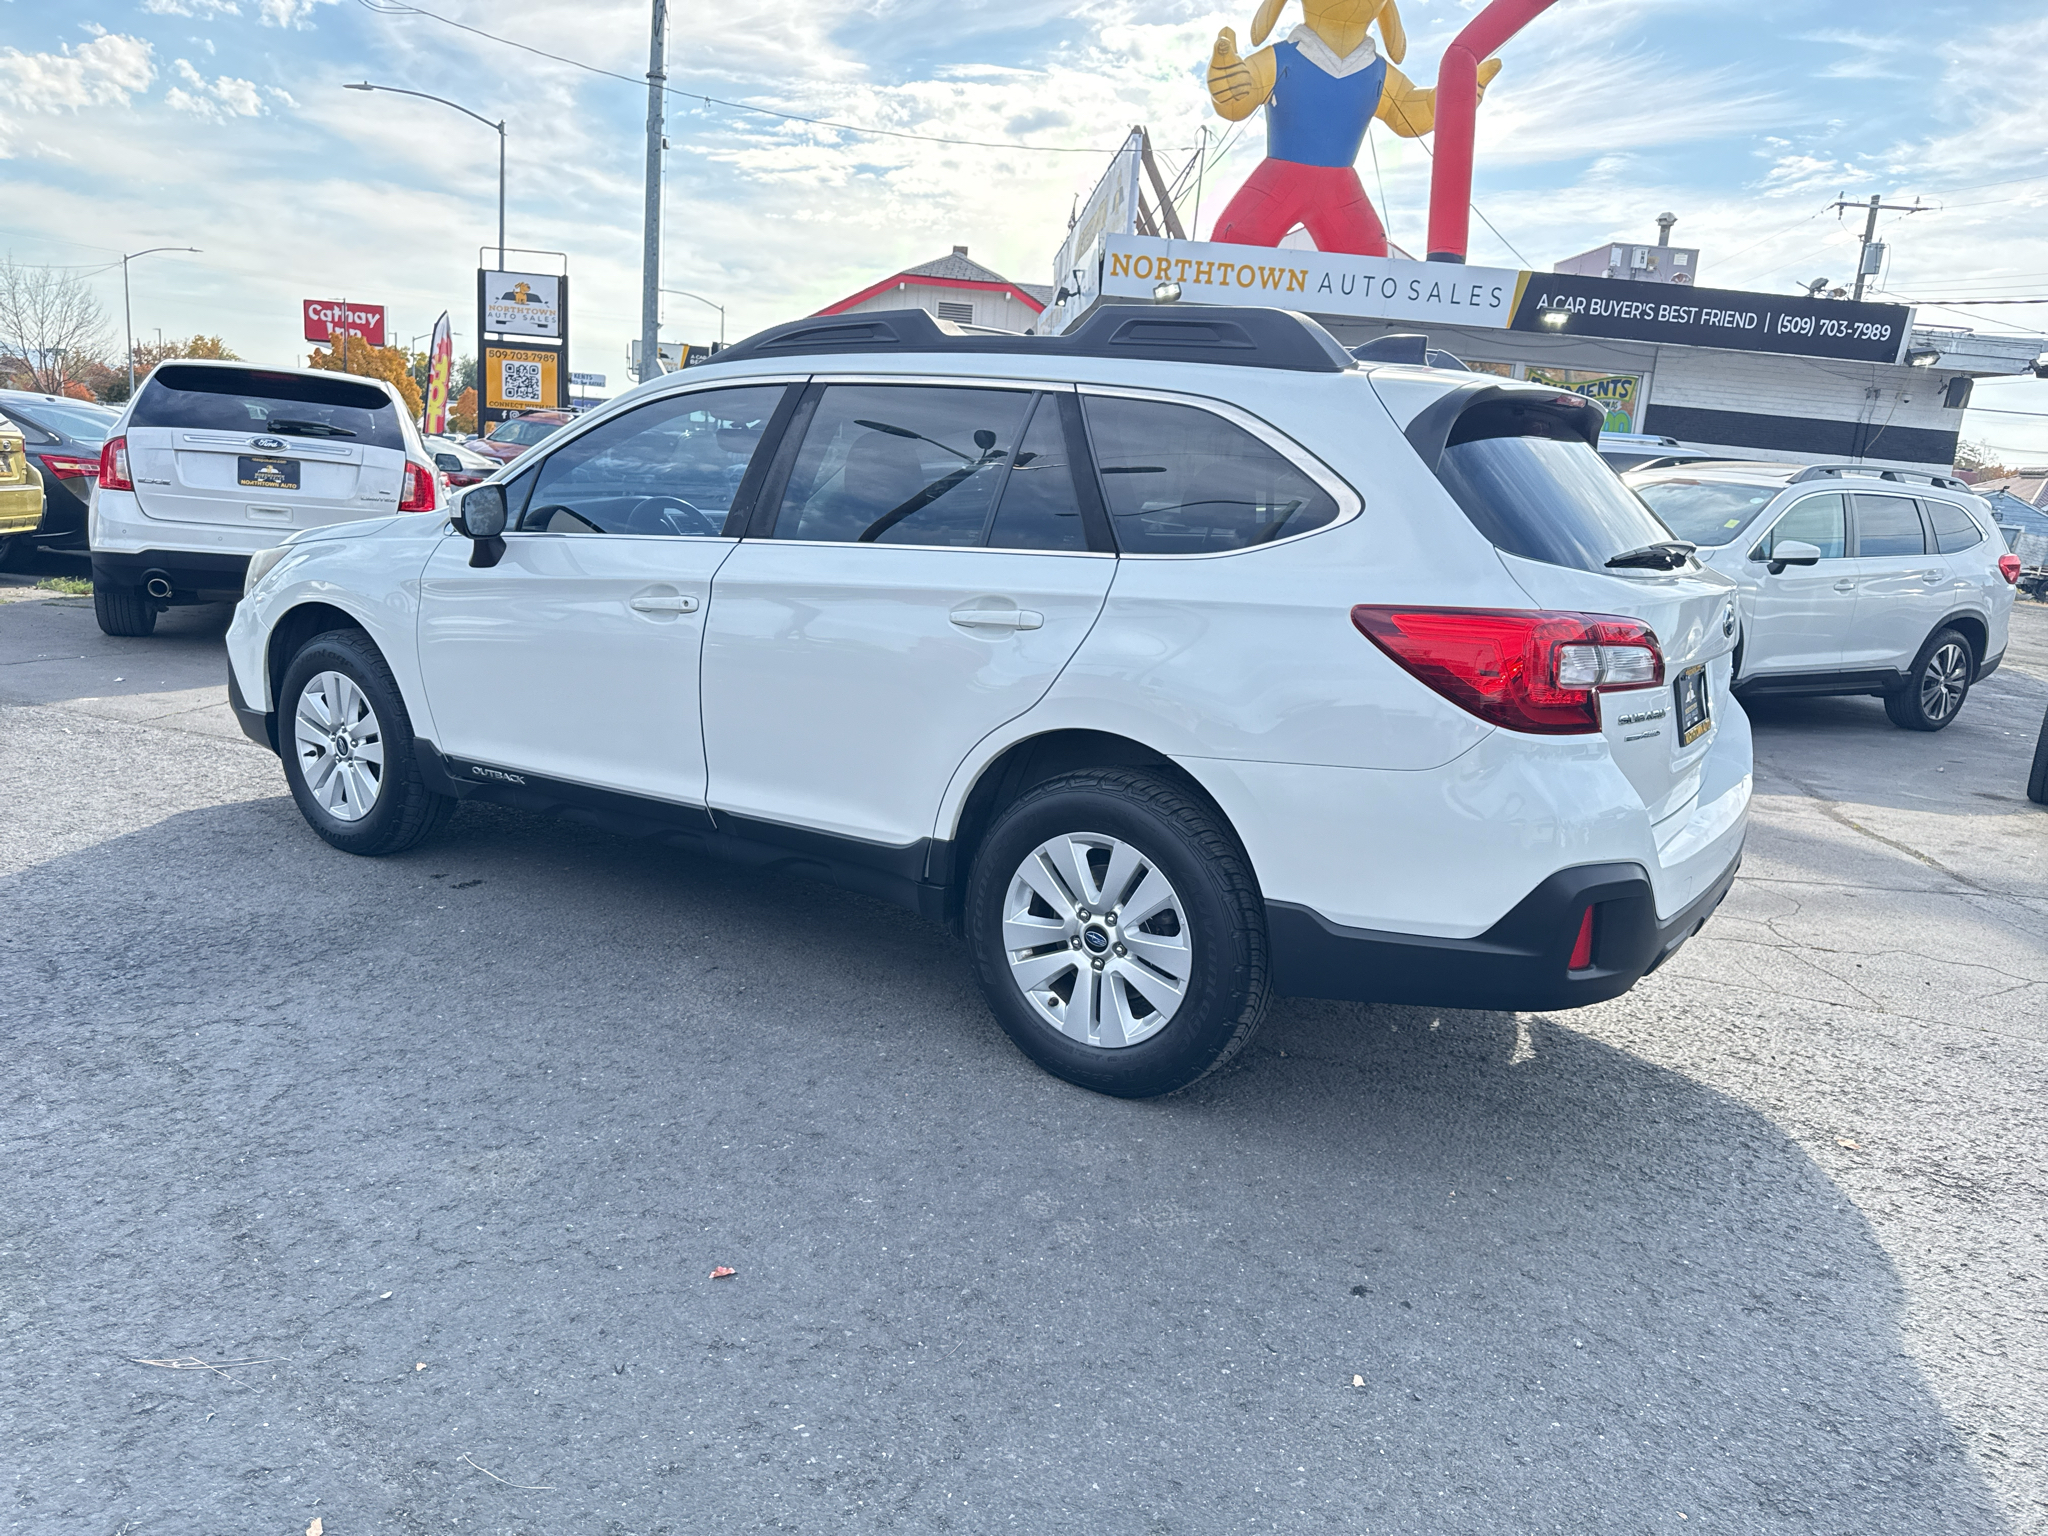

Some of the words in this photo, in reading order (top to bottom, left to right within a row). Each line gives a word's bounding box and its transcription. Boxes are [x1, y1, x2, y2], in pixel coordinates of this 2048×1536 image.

[1110, 253, 1309, 293] NORTHTOWN
[1318, 272, 1397, 299] AUTO
[1408, 279, 1502, 309] SALES
[308, 304, 381, 329] Cathay
[488, 304, 557, 316] NORTHTOWN
[487, 312, 516, 320] AUTO
[522, 314, 557, 324] SALES
[1536, 294, 1549, 310] A
[1553, 296, 1586, 314] CAR
[1589, 298, 1656, 320] BUYER'S
[1658, 304, 1699, 324] BEST
[1700, 308, 1758, 329] FRIEND
[1777, 313, 1816, 337] (509)
[1819, 319, 1892, 341] 703-7989
[488, 350, 556, 363] 509-703-7989
[488, 401, 524, 409] CONNECT
[258, 439, 279, 448] Ford
[241, 479, 279, 487] NORTHTOWN
[1618, 707, 1671, 725] SUBARU
[472, 766, 526, 785] OUTBACK
